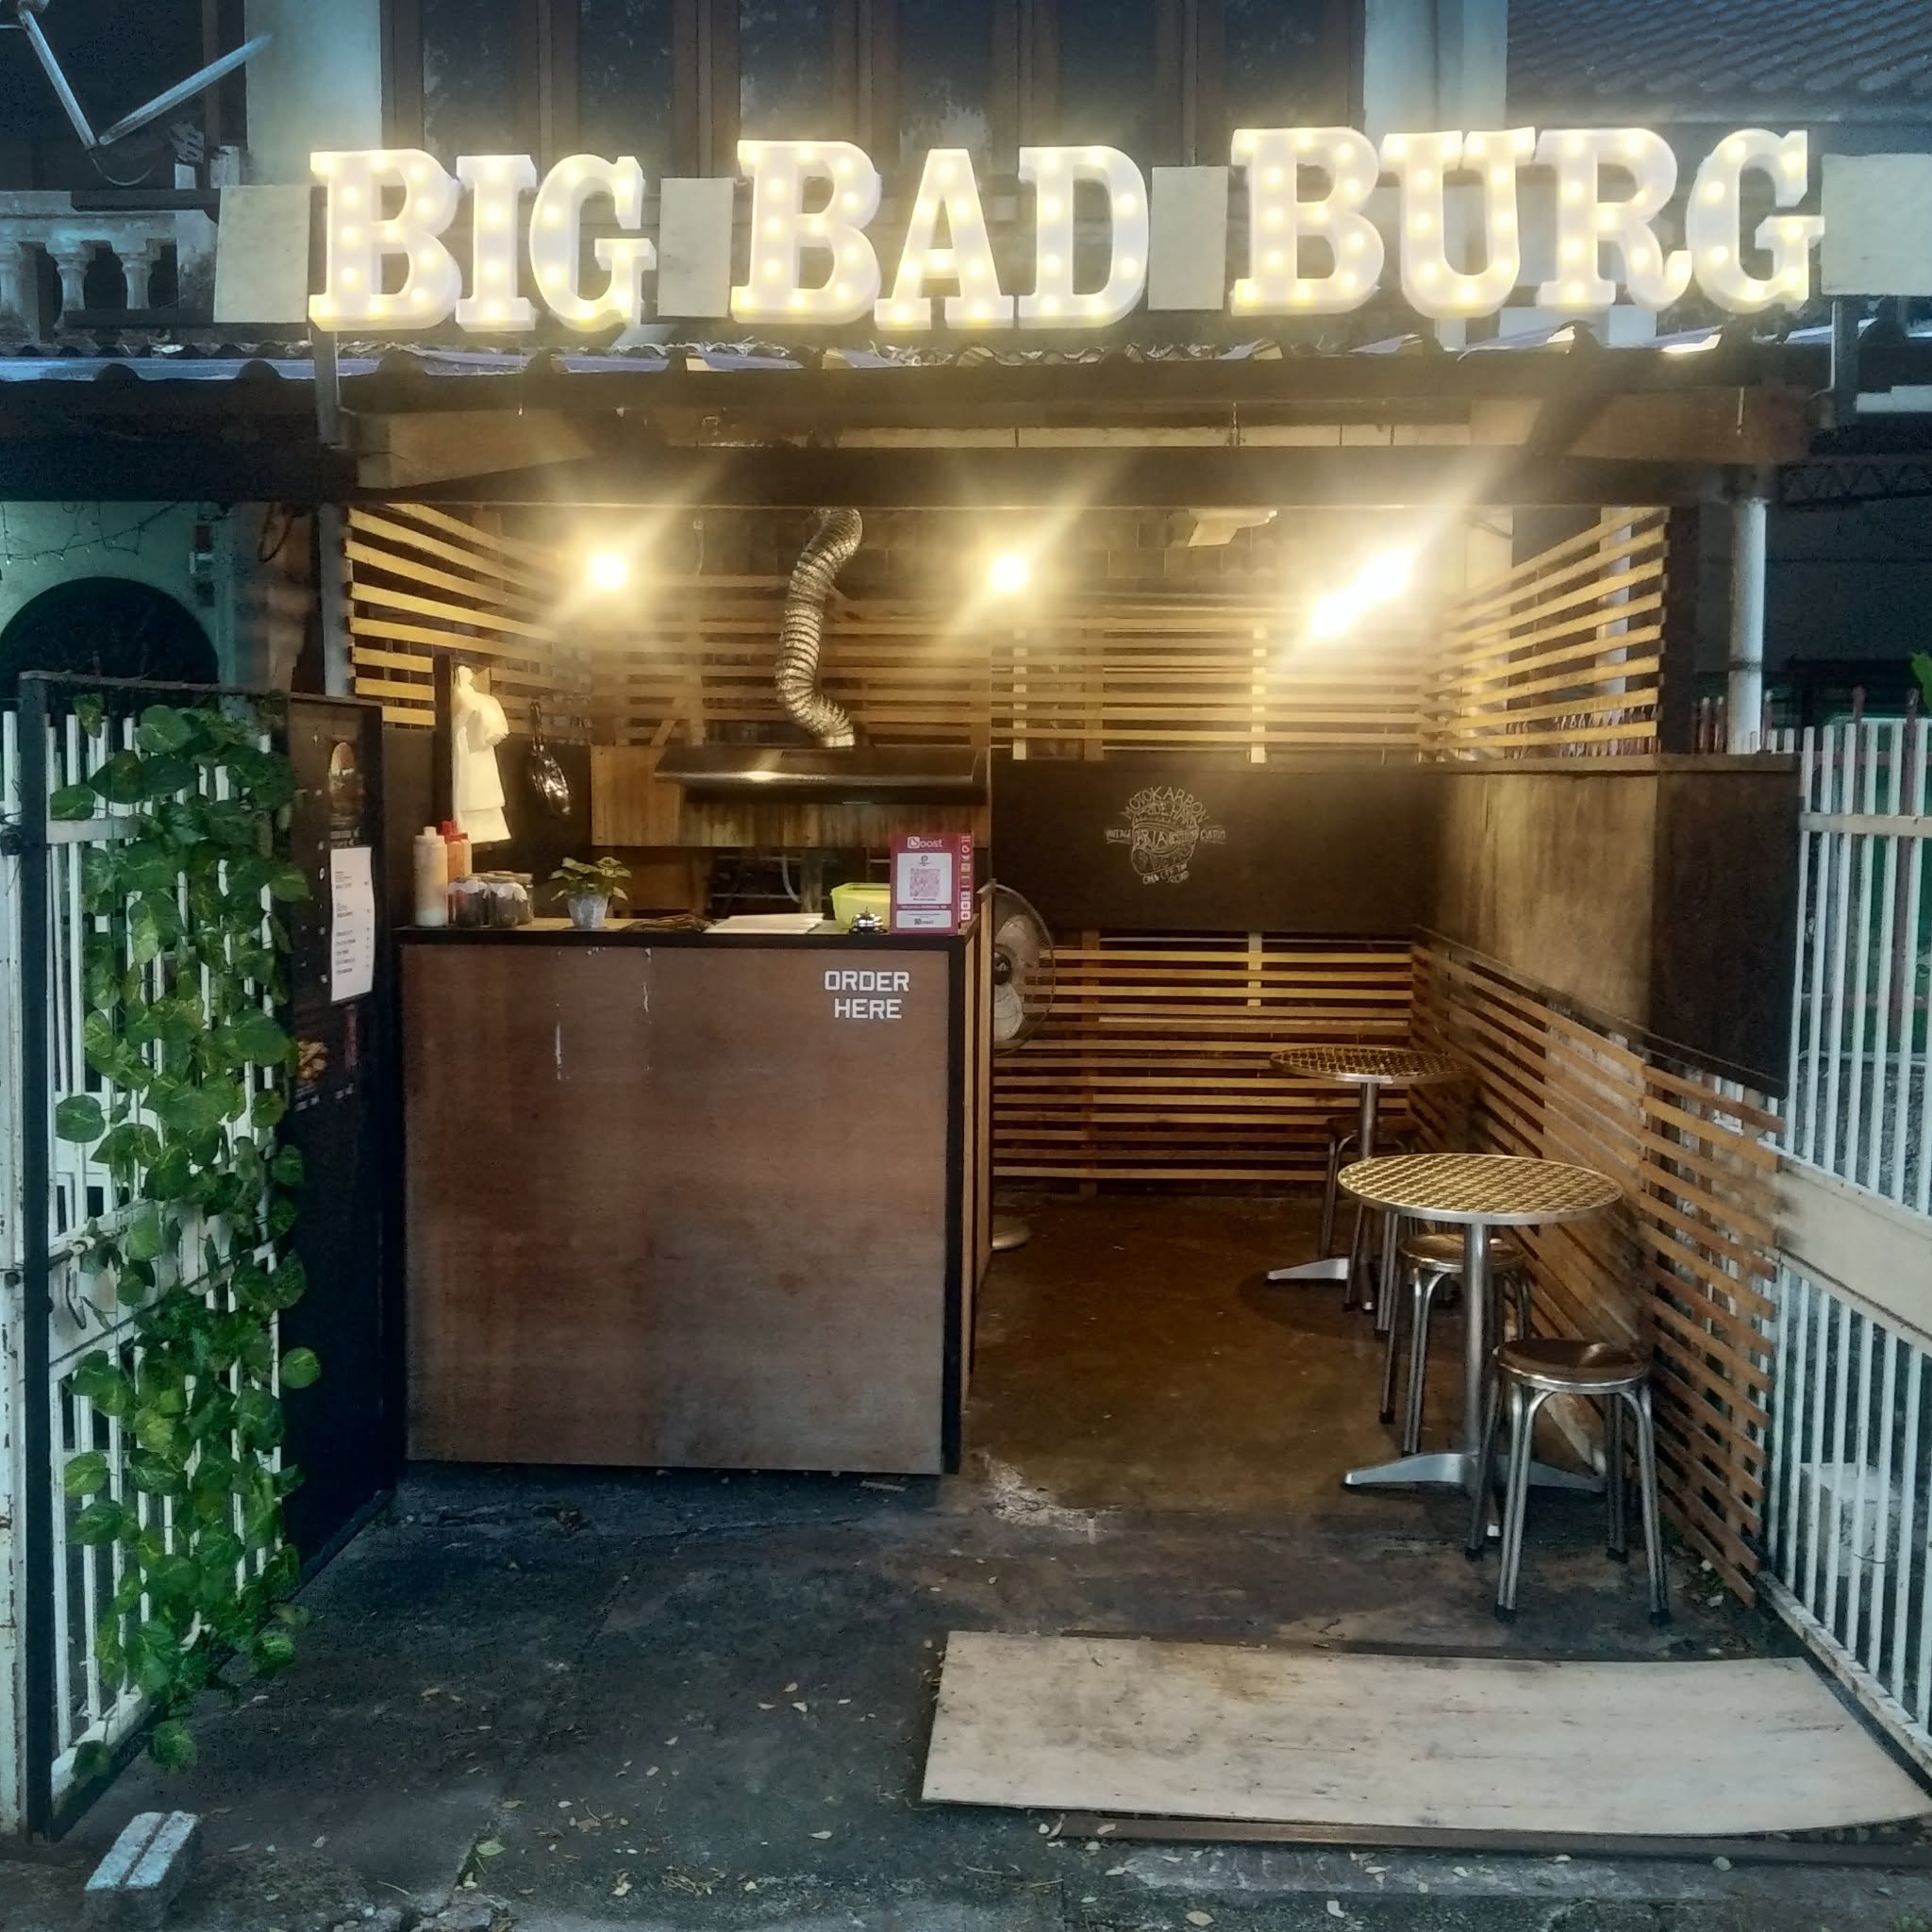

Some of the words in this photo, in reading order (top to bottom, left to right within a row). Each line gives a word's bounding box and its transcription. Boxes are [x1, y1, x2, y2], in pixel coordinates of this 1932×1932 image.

[309, 148, 657, 333] BIG
[730, 139, 1150, 332] BAD
[1230, 126, 1825, 320] BURG
[824, 970, 910, 991] ORDER
[834, 997, 903, 1020] HERE
